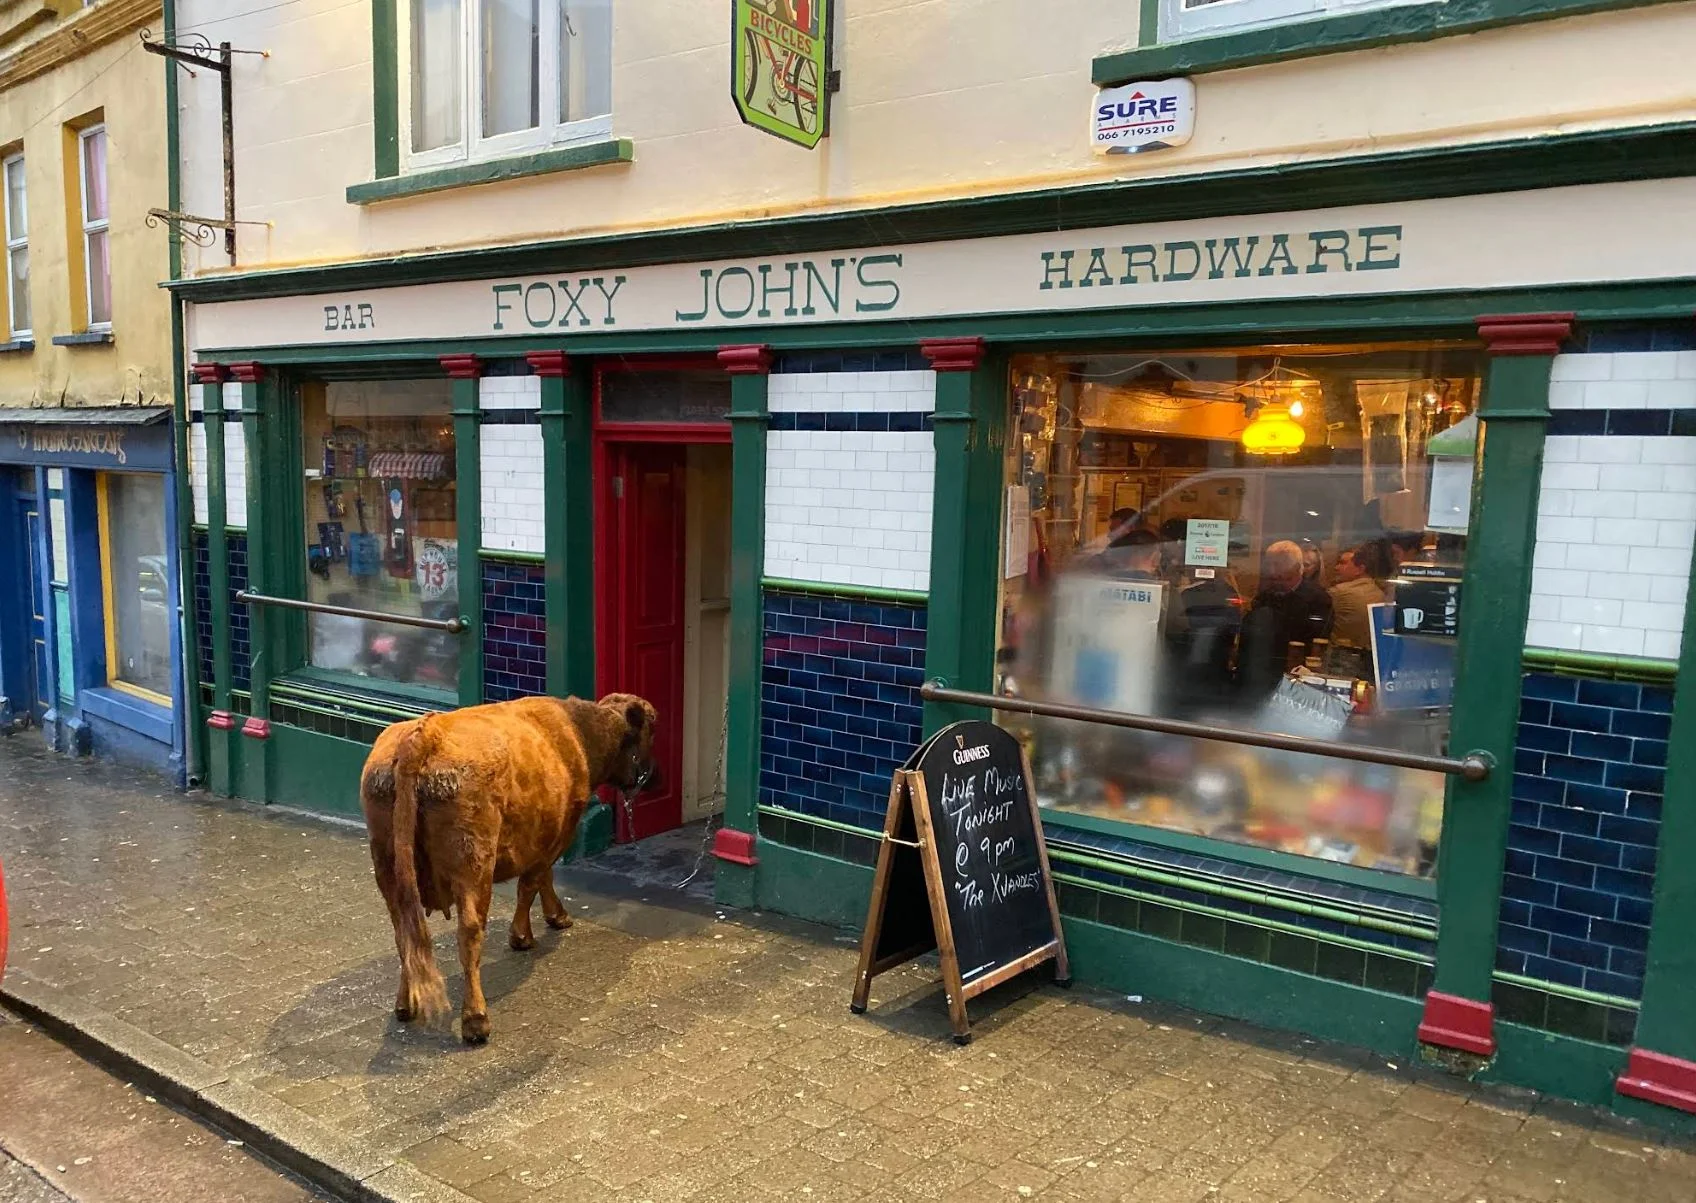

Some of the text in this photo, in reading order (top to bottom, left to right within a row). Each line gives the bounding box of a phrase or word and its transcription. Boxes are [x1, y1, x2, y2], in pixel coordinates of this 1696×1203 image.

[750, 8, 812, 55] BICYCLES
[1097, 96, 1177, 122] SURE
[1097, 125, 1174, 141] 066 7195210
[324, 225, 1403, 331] BAR FOXY JOHN'S HARDWARE
[423, 563, 444, 587] 13
[953, 744, 990, 765] GUINNESS
[955, 842, 969, 878] @
